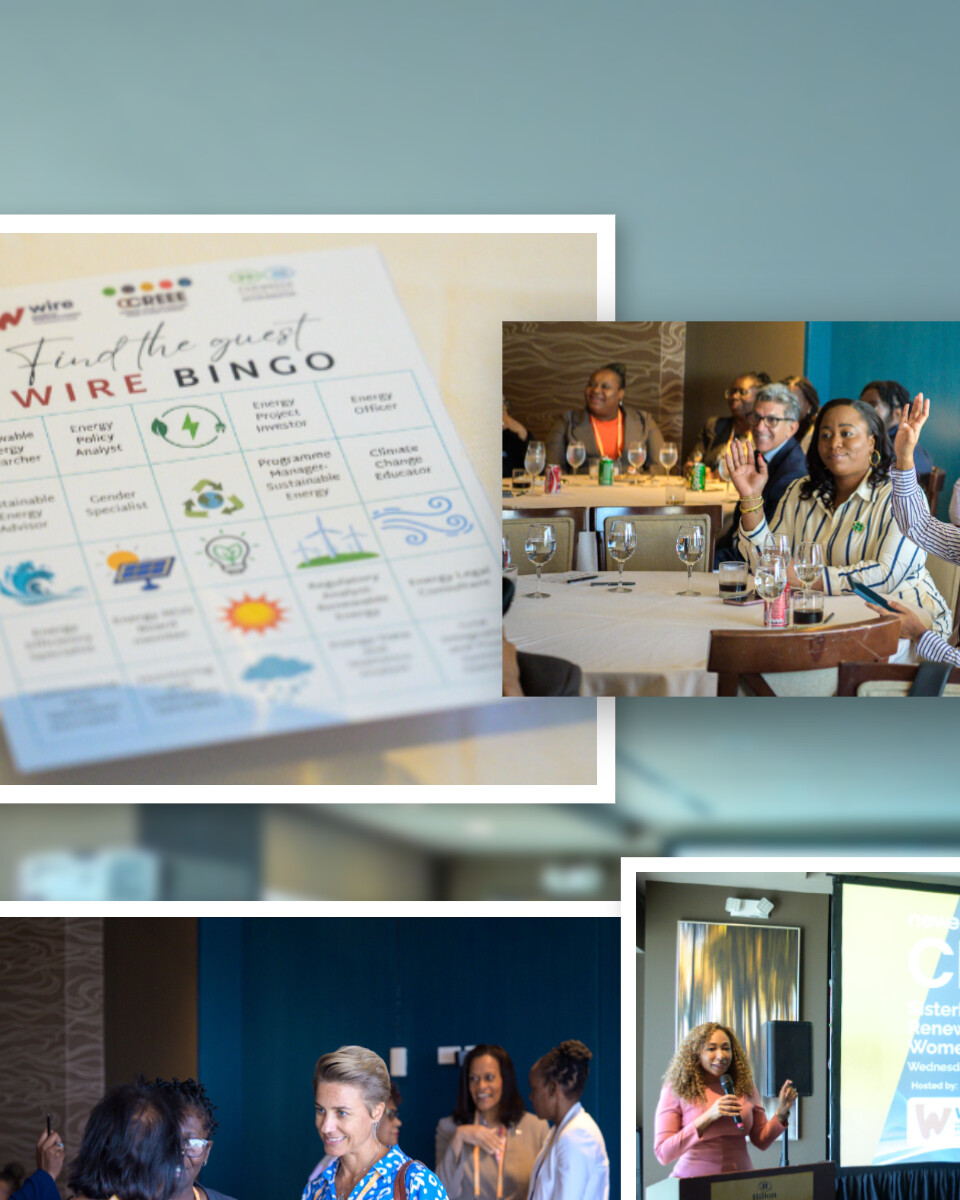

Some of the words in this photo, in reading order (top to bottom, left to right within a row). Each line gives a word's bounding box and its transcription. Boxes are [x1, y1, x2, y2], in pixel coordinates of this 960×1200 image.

[29, 299, 74, 313] wire
[5, 335, 128, 386] Find
[136, 320, 196, 372] the
[210, 312, 322, 362] guest
[11, 373, 148, 409] WIRE
[173, 352, 336, 389] BINGO
[253, 398, 295, 410] Energy
[350, 392, 393, 404] Energy
[256, 408, 301, 421] Project
[353, 402, 398, 415] Officer
[70, 420, 114, 434] Energy
[256, 420, 307, 433] Investor
[75, 432, 115, 446] Policy
[75, 443, 123, 457] Analyst
[369, 444, 419, 458] Climate
[258, 450, 332, 467] Programme
[375, 455, 423, 469] Change
[269, 464, 329, 478] Manager-
[375, 465, 431, 481] Educator
[266, 473, 341, 491] Sustainable
[0, 494, 55, 509] tainable
[89, 491, 136, 504] Gender
[286, 488, 329, 501] Energy
[85, 501, 148, 517] Specialist
[0, 521, 47, 533] Advisor
[911, 1081, 943, 1091] Hosted
[945, 1081, 958, 1092] by:
